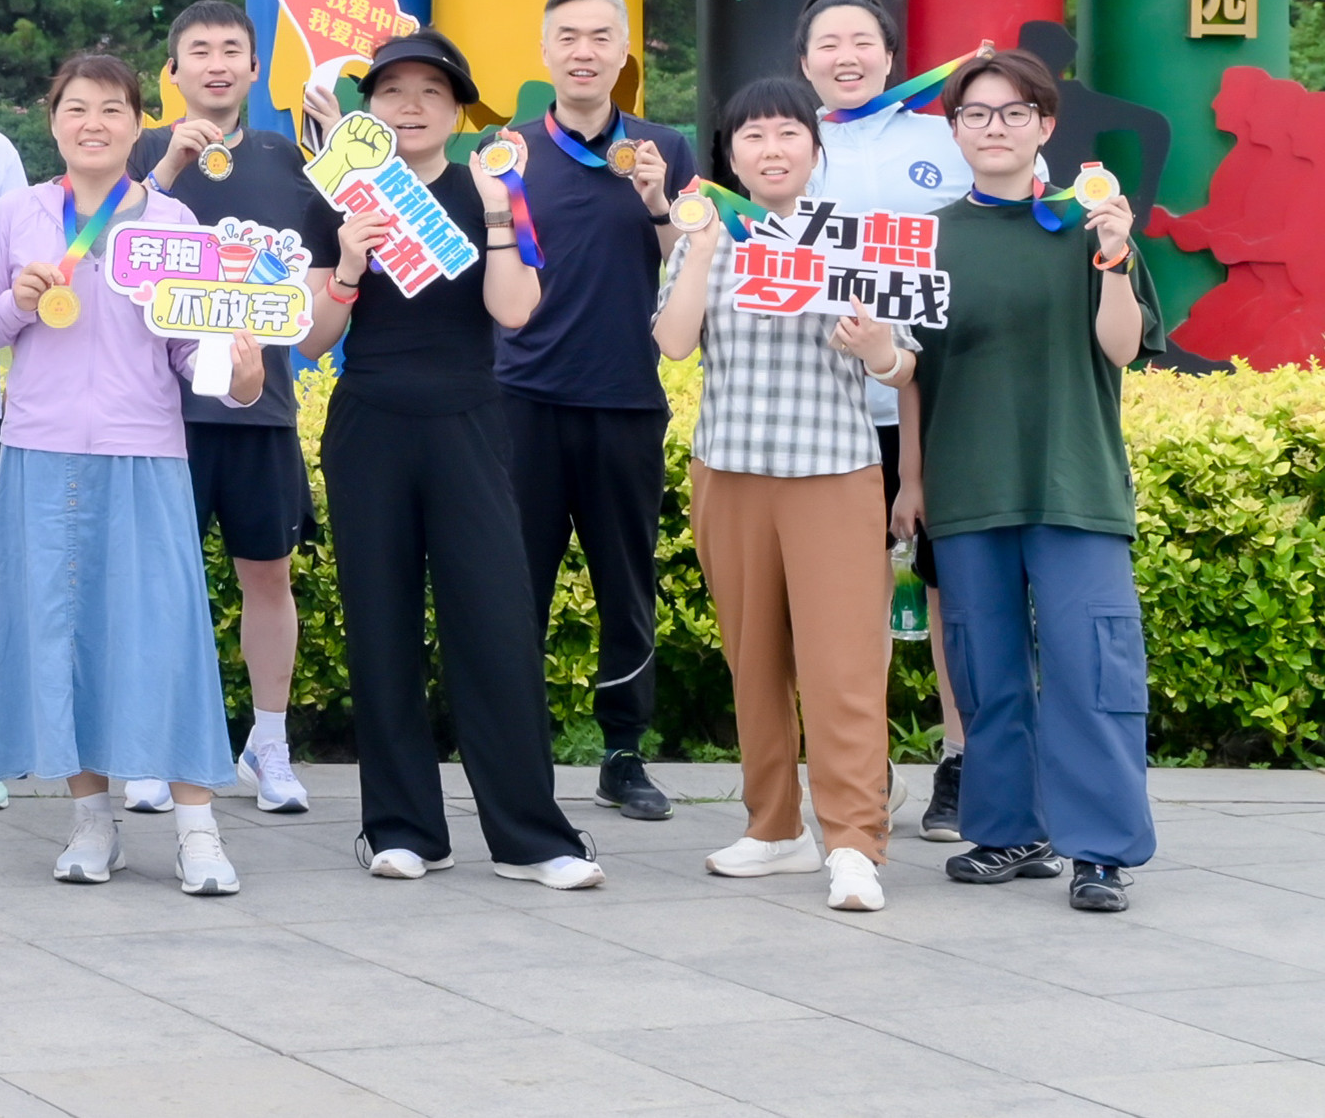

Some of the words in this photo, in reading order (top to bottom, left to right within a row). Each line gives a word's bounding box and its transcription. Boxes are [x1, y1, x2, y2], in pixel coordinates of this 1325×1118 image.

[308, 8, 387, 59] 我爱运
[914, 167, 938, 187] 15
[373, 160, 475, 275] 披荆斩棘
[128, 235, 202, 274] 奔跑
[166, 287, 291, 331] 不放弃
